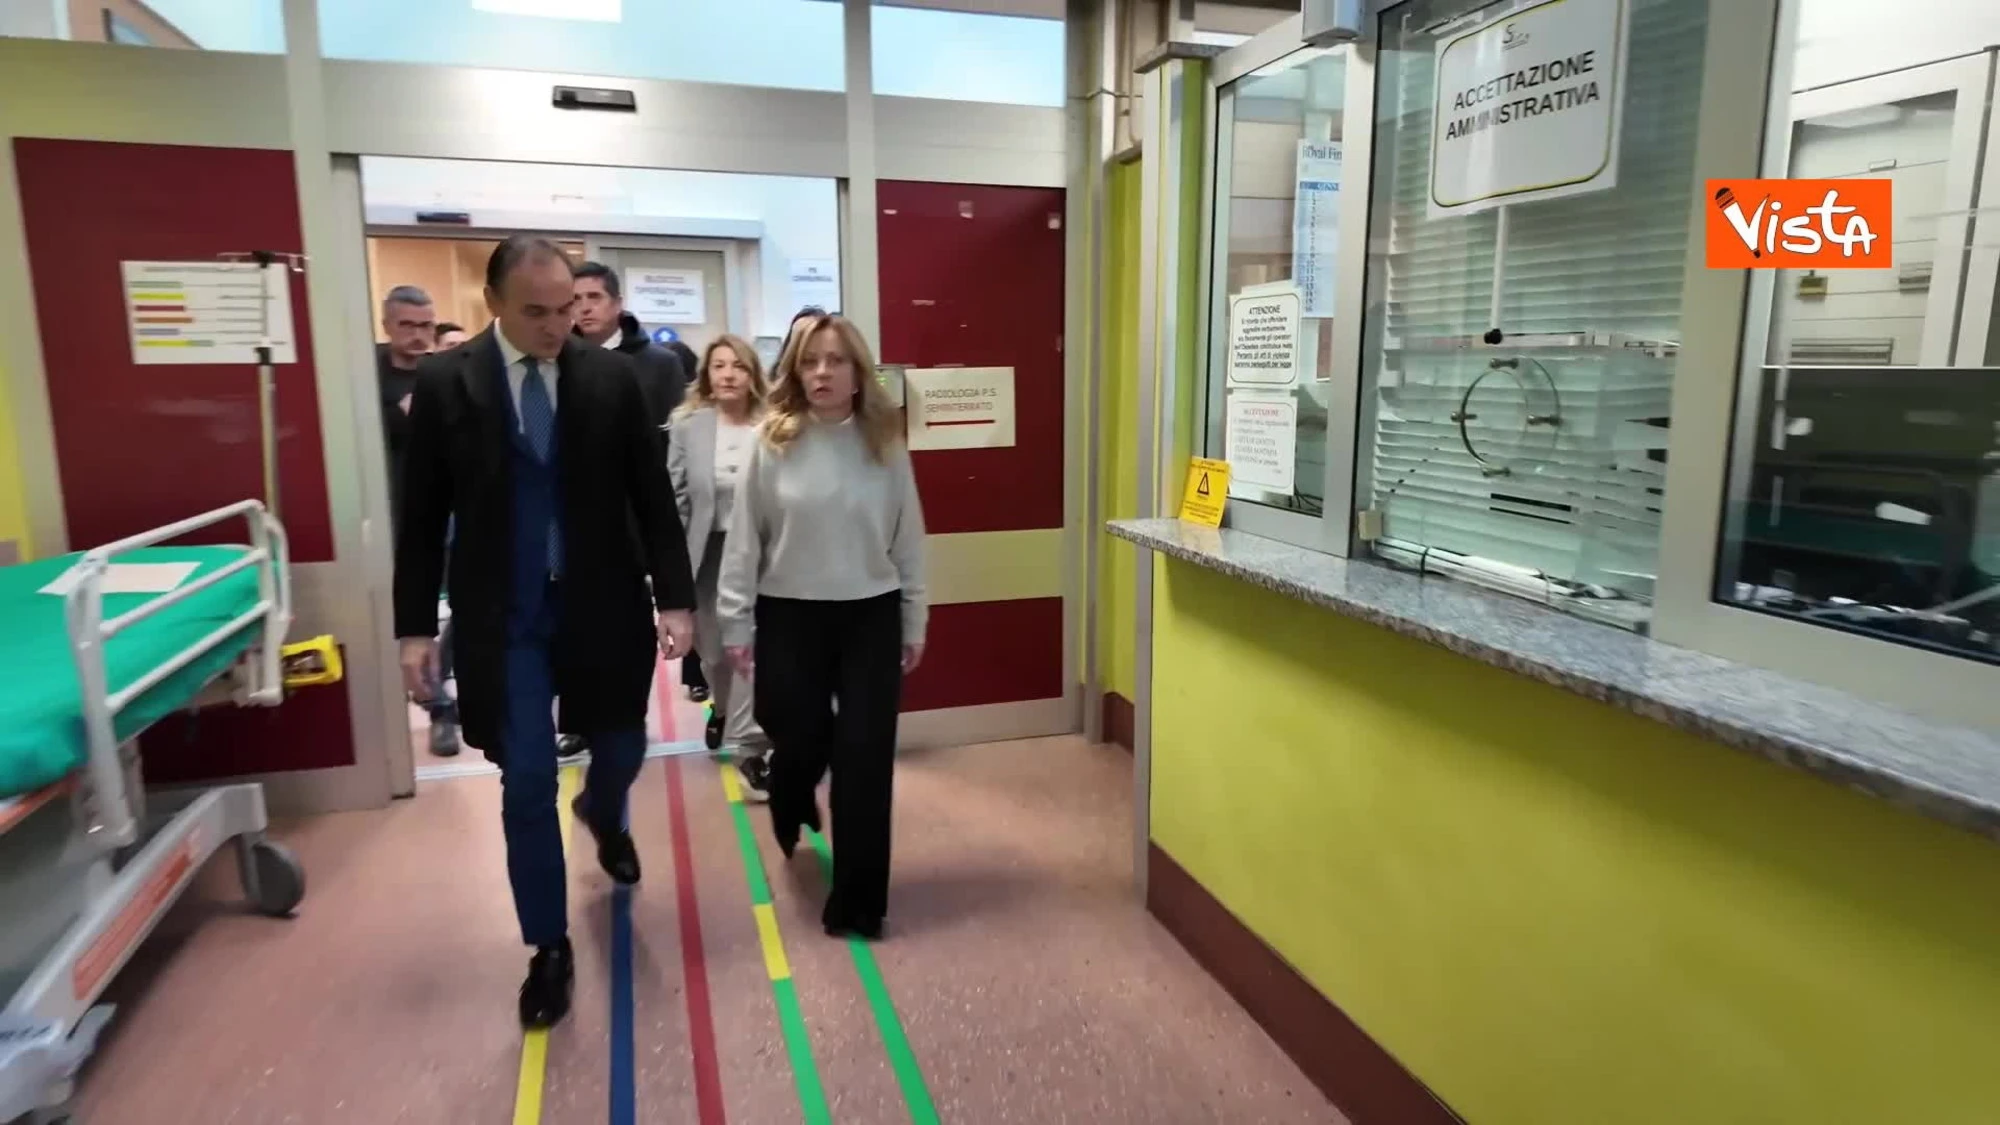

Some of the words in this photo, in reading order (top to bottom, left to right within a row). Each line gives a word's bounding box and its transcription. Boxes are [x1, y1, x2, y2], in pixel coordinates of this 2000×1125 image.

[1453, 50, 1596, 111] ACCETTAZIONE
[1446, 81, 1600, 141] AMMINISTRATIVA
[1249, 304, 1281, 315] ATTENZIONE
[924, 388, 980, 399] RADIOLOGIA
